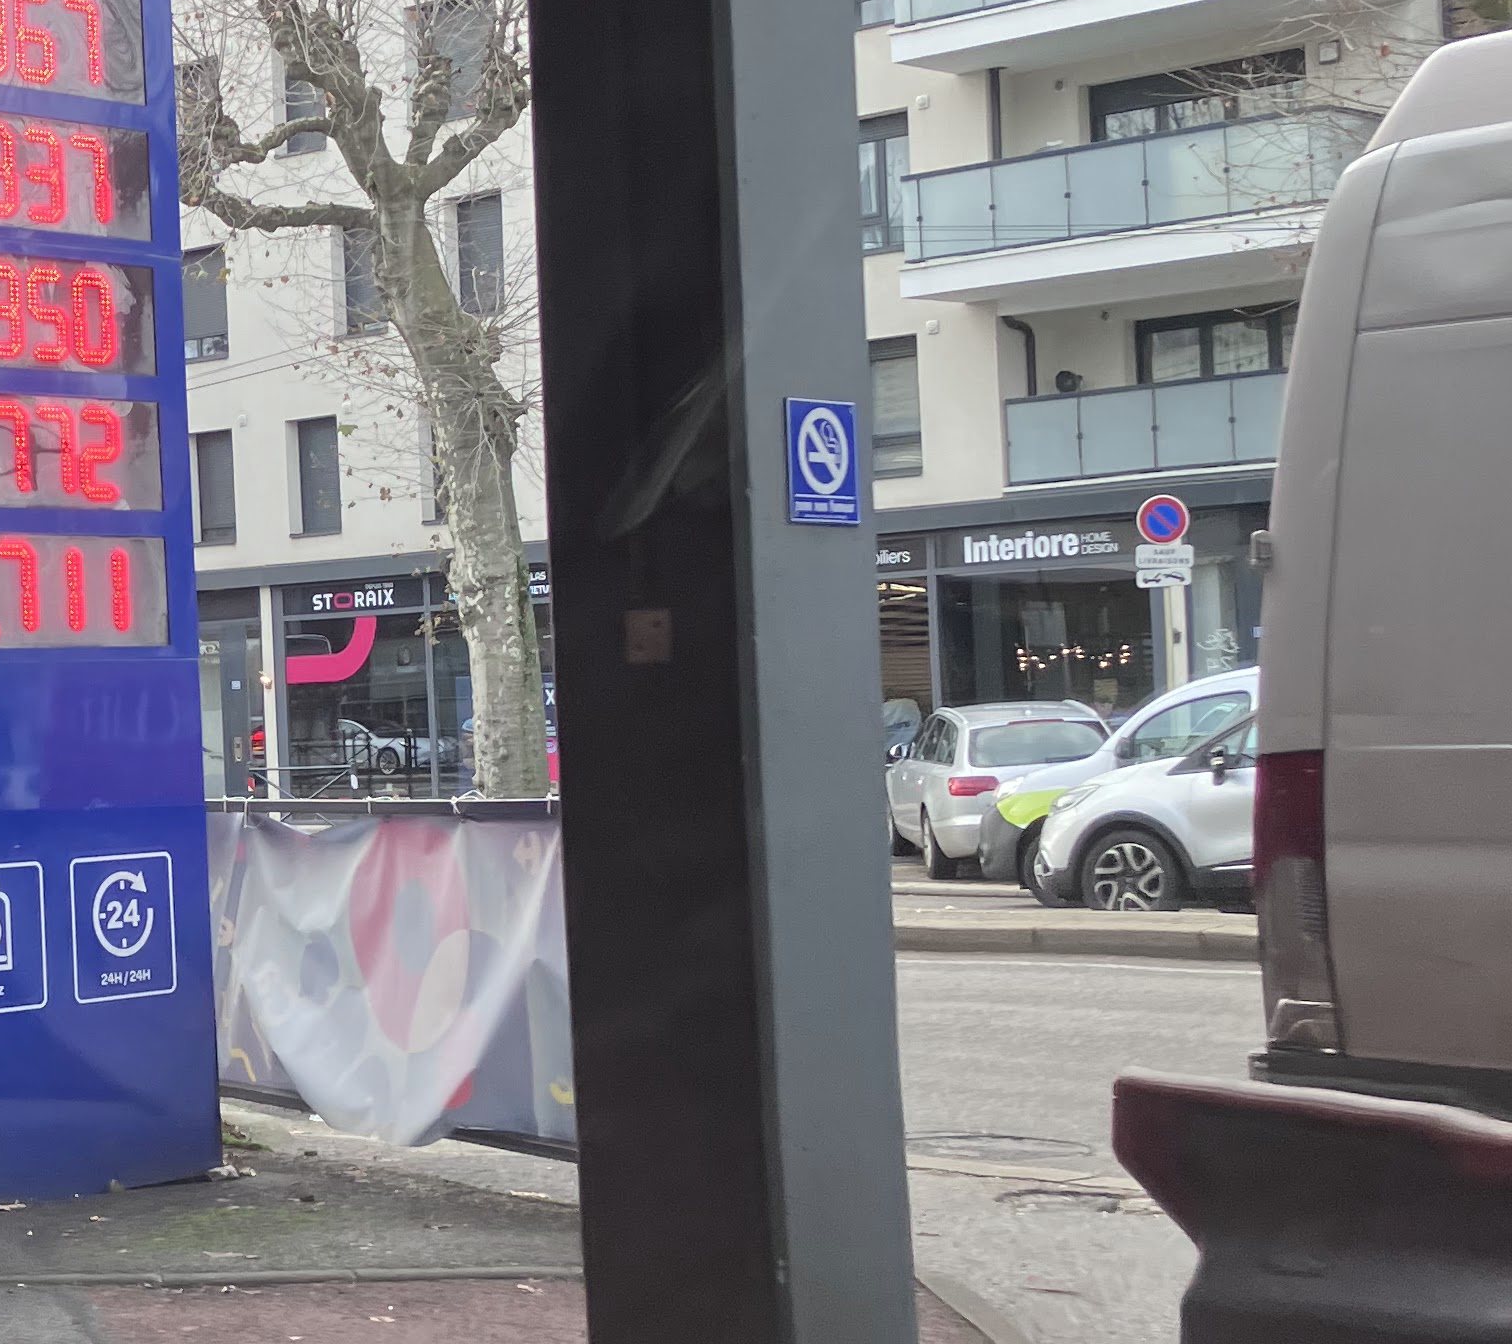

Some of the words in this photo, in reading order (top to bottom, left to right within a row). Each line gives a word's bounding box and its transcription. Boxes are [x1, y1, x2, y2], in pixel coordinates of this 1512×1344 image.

[963, 531, 1080, 564] Interiore
[1081, 531, 1112, 543] HOME
[1081, 543, 1120, 555] DESIGN
[312, 589, 395, 611] STORAIX
[106, 898, 140, 929] 24
[100, 969, 151, 986] 24H/24H
